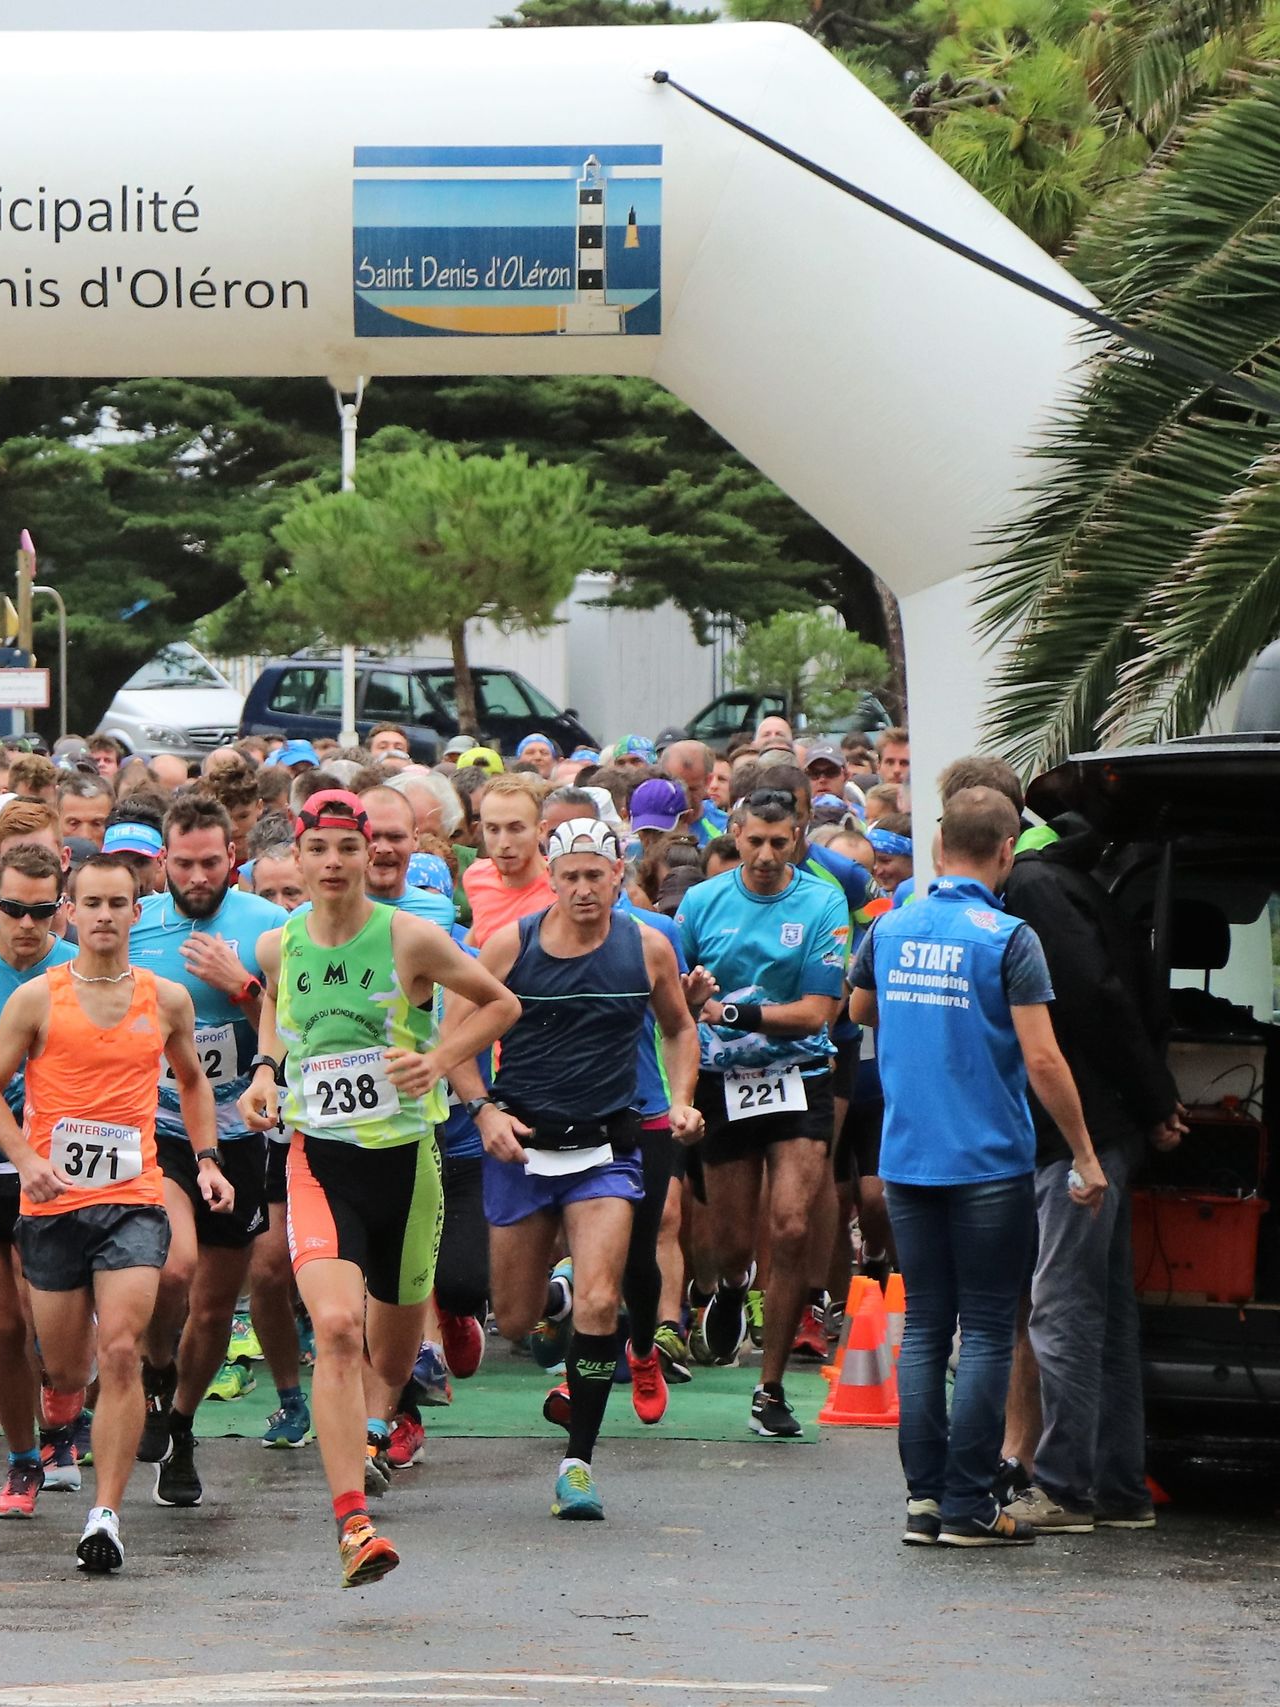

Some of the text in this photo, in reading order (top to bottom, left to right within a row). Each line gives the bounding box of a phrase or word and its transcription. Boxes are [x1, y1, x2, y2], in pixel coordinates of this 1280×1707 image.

[355, 254, 571, 289] Saint Denis d'Oléron
[79, 266, 310, 309] d'Oléron
[899, 941, 964, 972] STAFF
[887, 969, 969, 992] Chronométrie
[319, 1008, 329, 1018] DU
[330, 1007, 355, 1019] MONDE
[310, 1051, 381, 1072] INTERSPORT
[316, 1073, 379, 1116] 238
[738, 1078, 786, 1109] 221
[65, 1122, 134, 1141] INTERSPORT
[64, 1142, 119, 1180] 371
